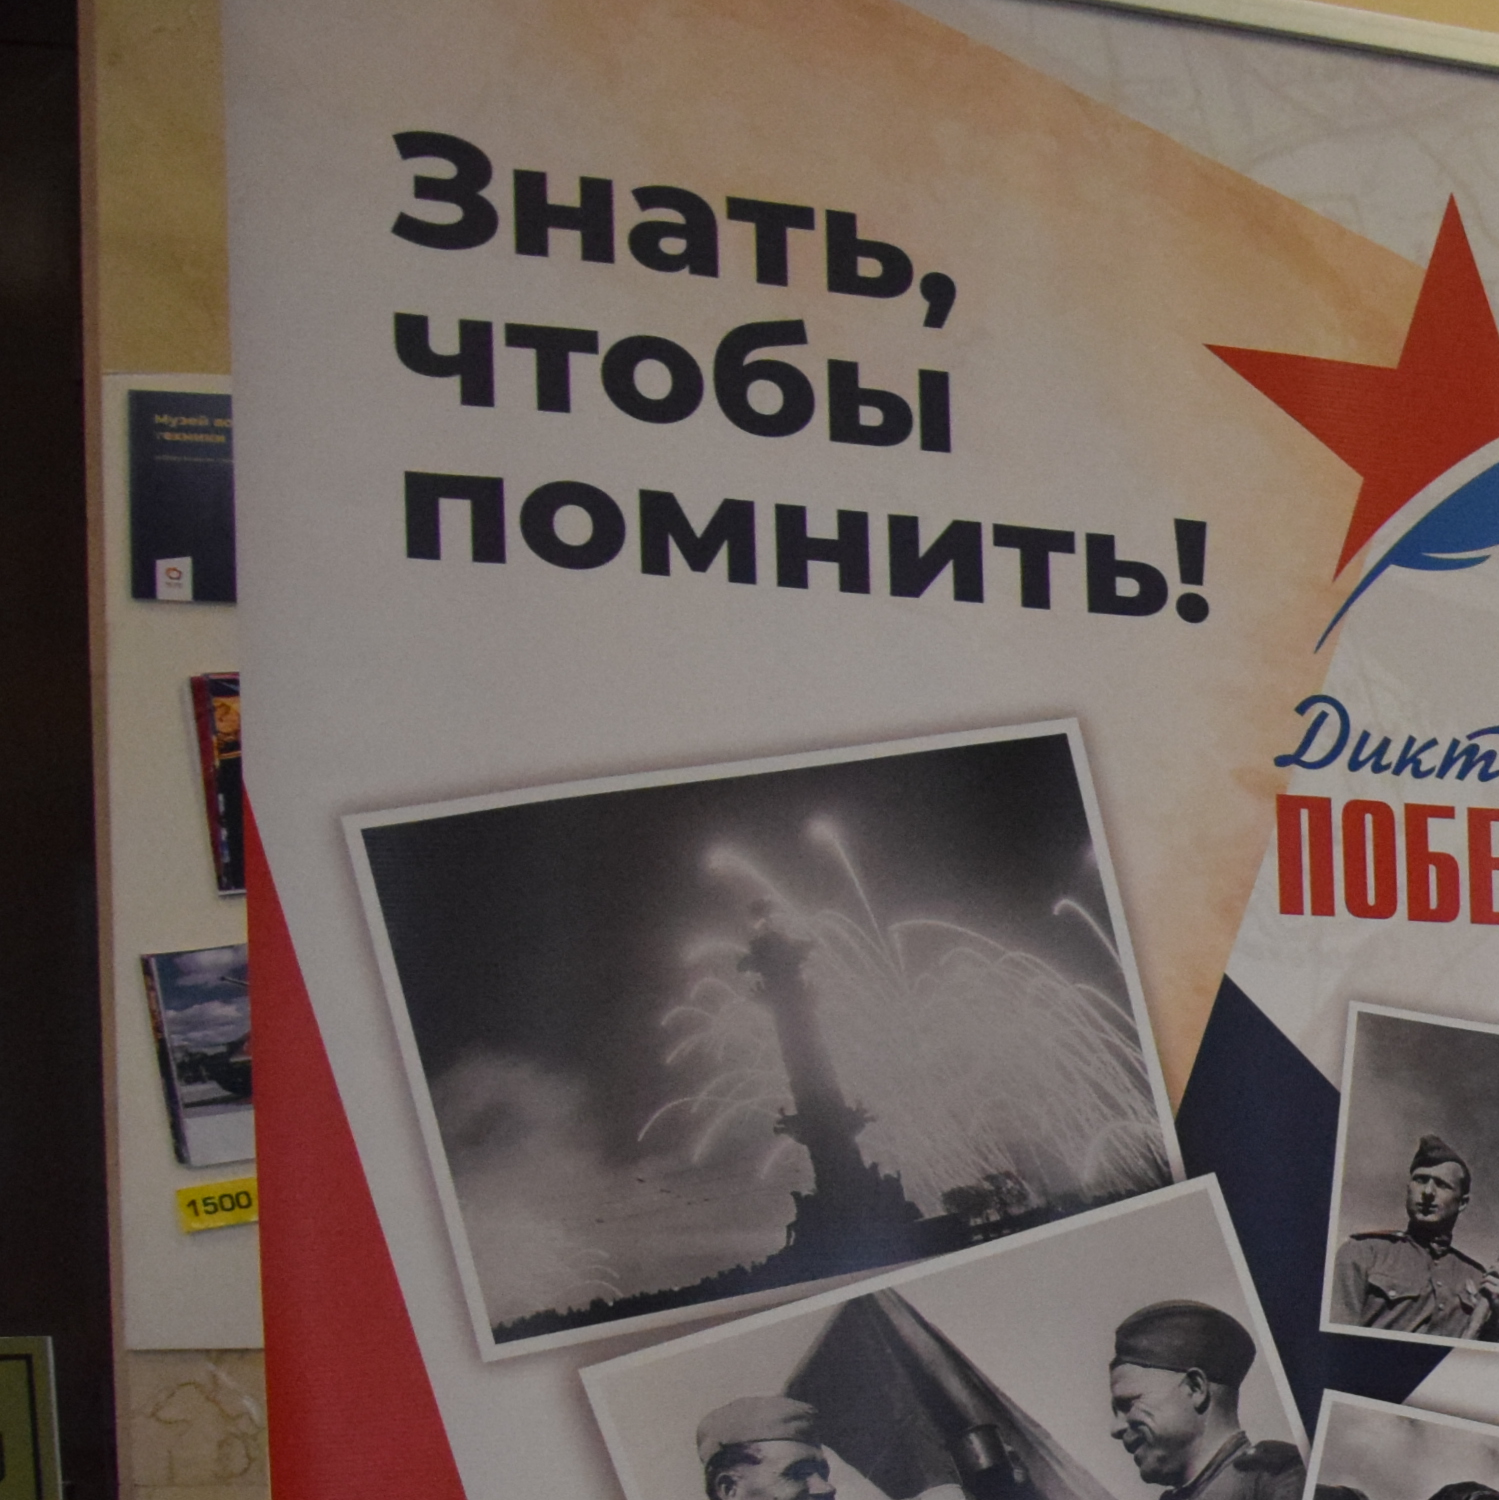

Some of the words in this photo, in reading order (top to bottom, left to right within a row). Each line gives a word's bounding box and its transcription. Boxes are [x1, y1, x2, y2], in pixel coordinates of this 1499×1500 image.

[389, 130, 957, 329] Знать,
[393, 311, 952, 454] чтобы
[403, 470, 1210, 624] помнить!
[186, 1191, 252, 1217] 1500
